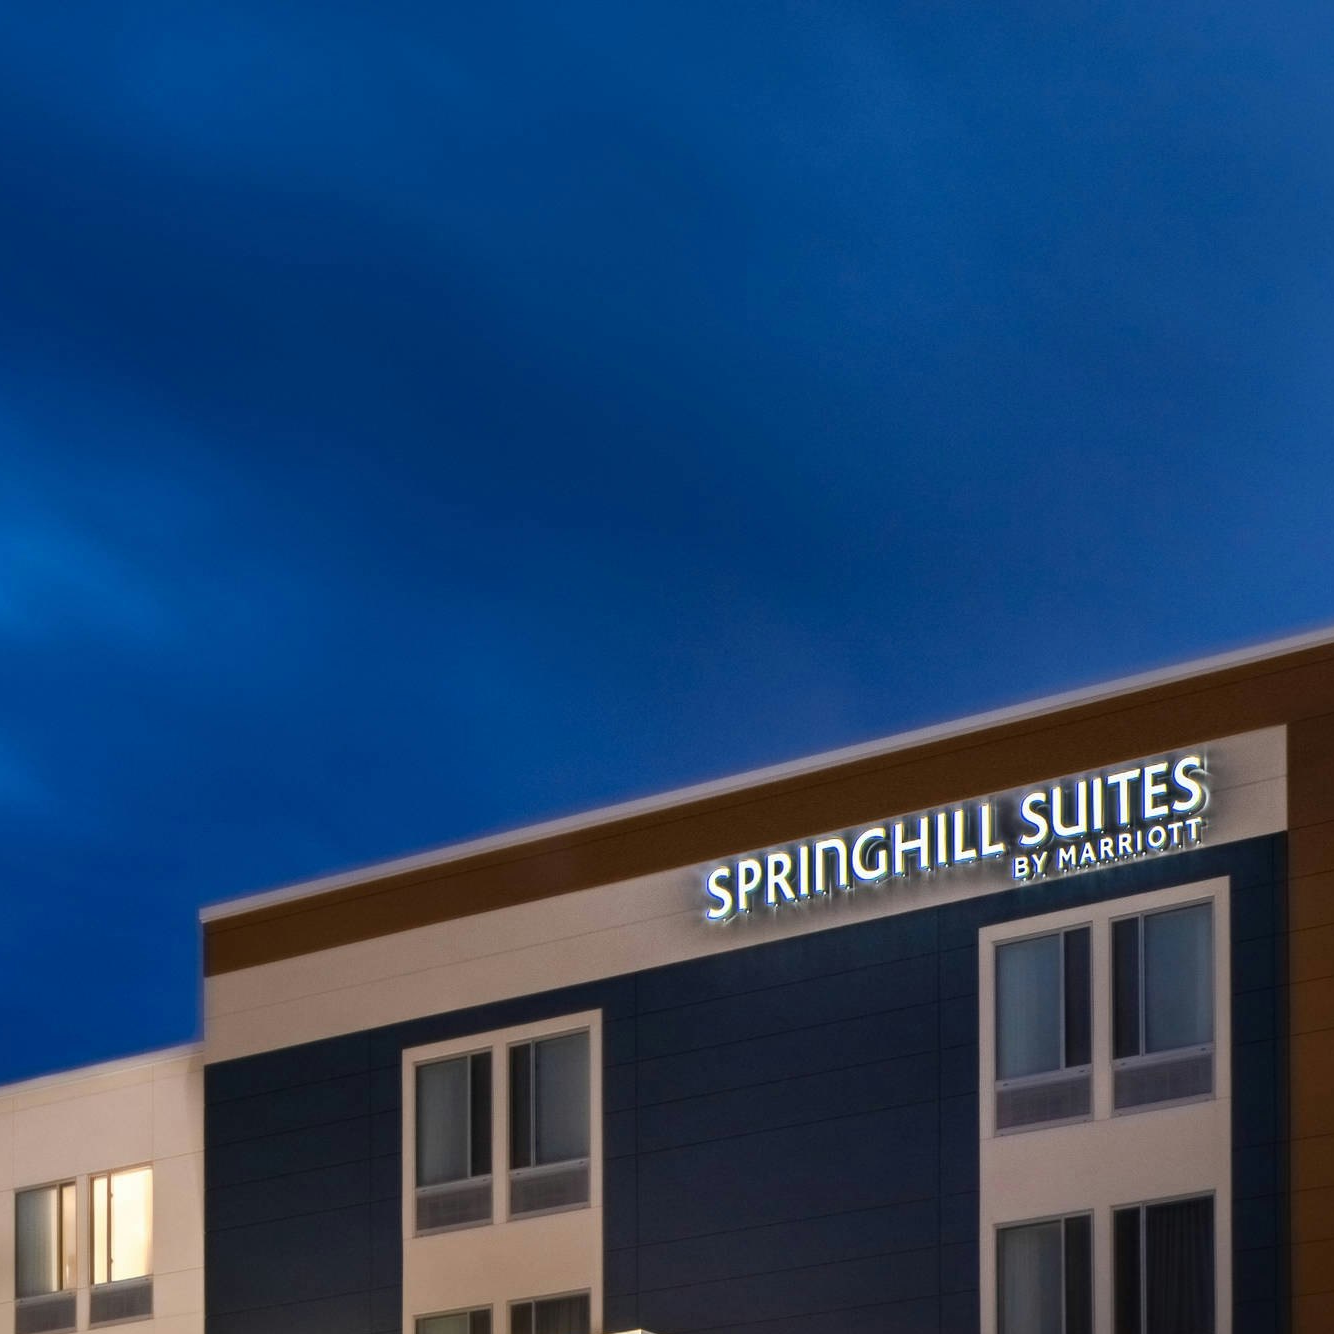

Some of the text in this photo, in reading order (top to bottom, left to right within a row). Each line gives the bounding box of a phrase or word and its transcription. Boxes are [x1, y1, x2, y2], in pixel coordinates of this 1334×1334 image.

[706, 756, 1203, 921] SPRINGHILL SUITES
[1013, 816, 1203, 879] BY MARRIOTT
